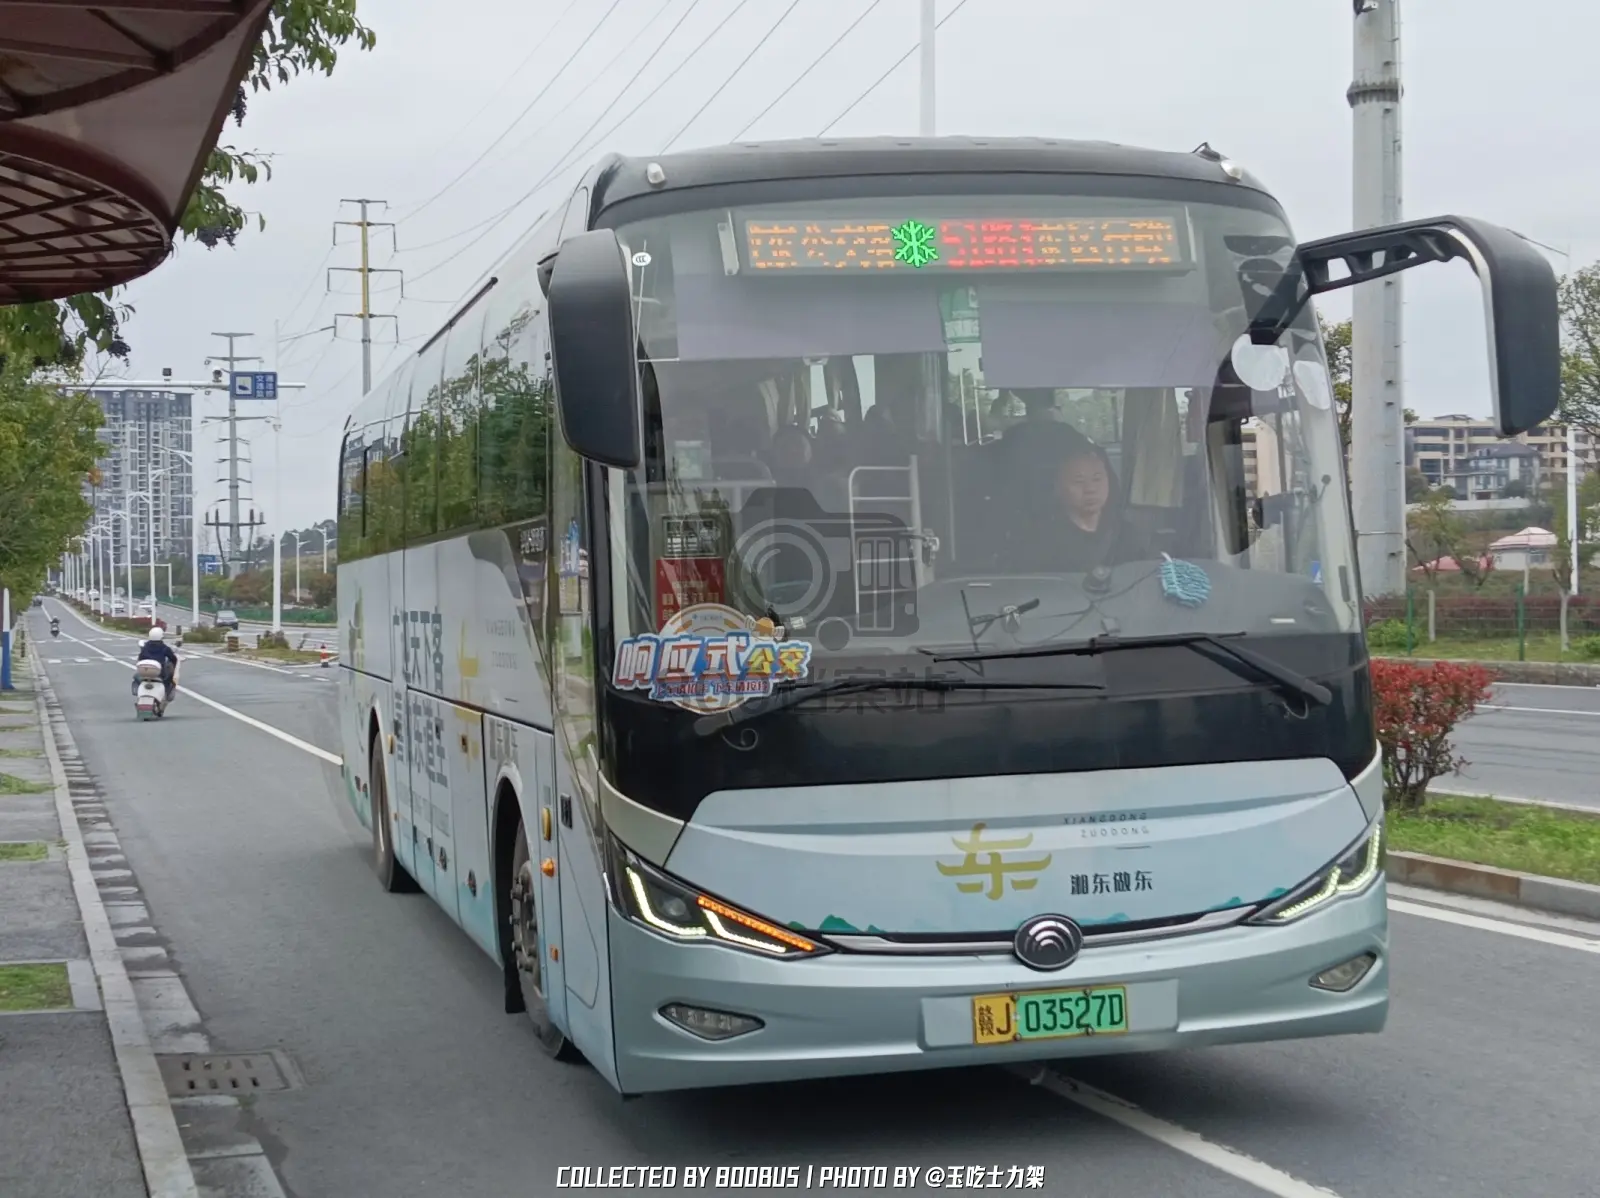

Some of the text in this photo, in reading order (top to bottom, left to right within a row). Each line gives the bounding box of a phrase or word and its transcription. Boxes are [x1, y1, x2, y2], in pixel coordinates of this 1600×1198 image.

[614, 634, 808, 687] 响应式公交
[1062, 812, 1148, 826] XIANGDONG
[1080, 826, 1150, 839] ZUODONG
[1069, 869, 1153, 896] 湘东做东
